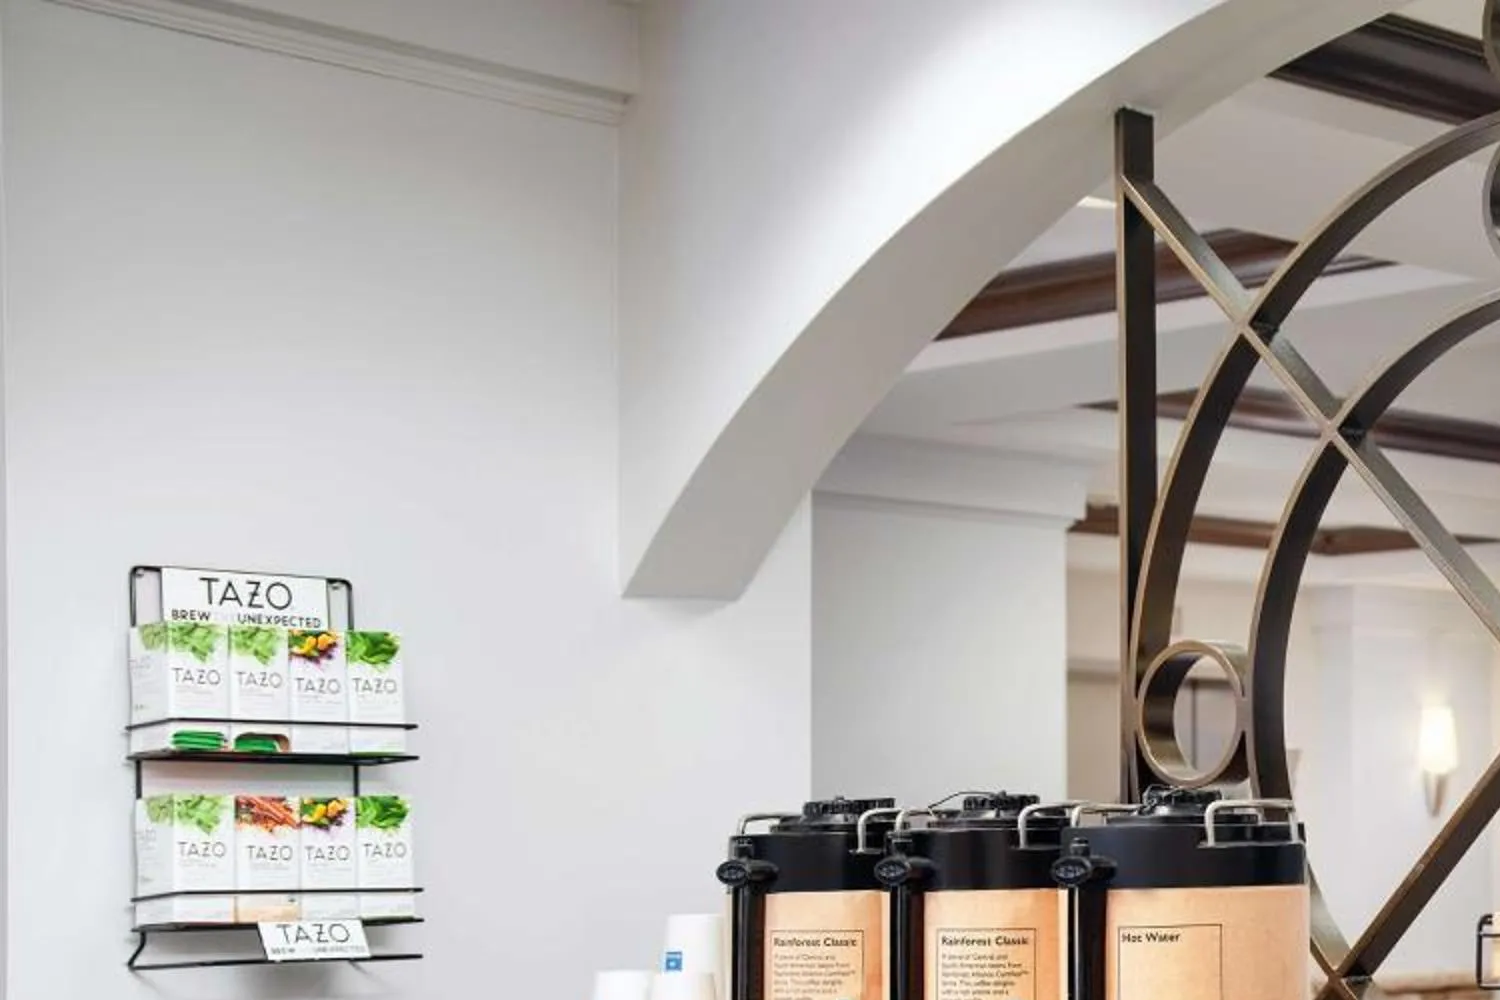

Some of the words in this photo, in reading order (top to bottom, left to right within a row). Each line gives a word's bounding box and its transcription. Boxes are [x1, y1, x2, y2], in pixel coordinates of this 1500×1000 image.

[199, 577, 292, 610] TAZO
[171, 609, 211, 621] BREW
[237, 613, 322, 629] UNEXPECTED
[171, 667, 221, 685] TAZO
[236, 671, 283, 689] TAZO
[295, 677, 341, 695] TAZO
[352, 677, 398, 694] TAZO
[177, 841, 227, 858] TAZO
[247, 845, 293, 861] TAZO
[304, 845, 350, 861] TAZO
[363, 842, 407, 858] TAZO
[276, 923, 350, 944] TAZO
[773, 937, 821, 947] Rainforest
[941, 935, 991, 947] Rainforest
[995, 935, 1029, 946] Classic
[1122, 933, 1142, 943] Hot
[1145, 932, 1181, 943] Water
